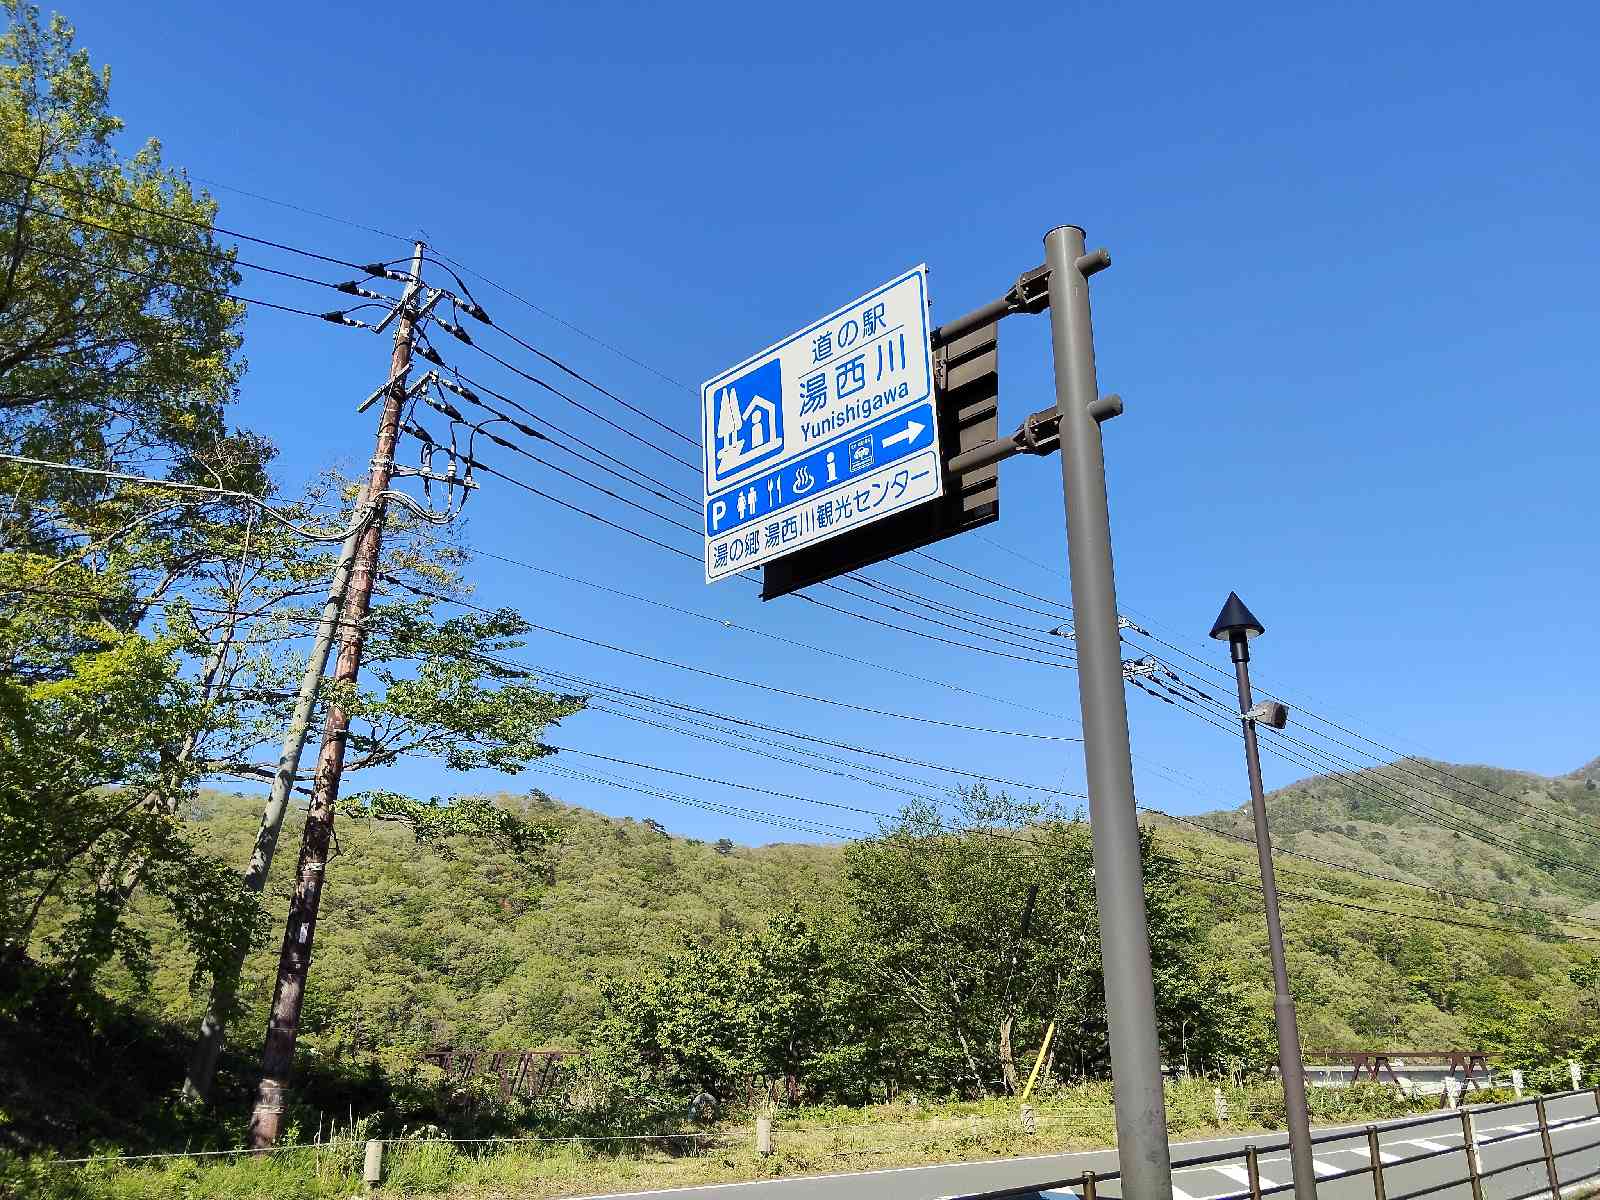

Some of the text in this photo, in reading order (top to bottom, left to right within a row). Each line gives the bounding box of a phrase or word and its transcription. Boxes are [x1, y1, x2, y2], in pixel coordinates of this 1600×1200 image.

[811, 302, 887, 364] 道の駅
[799, 334, 906, 417] 湯西川
[801, 382, 909, 442] Yunishigawa
[711, 502, 727, 530] P
[713, 470, 930, 568] 湯の郷 湯西川観光センター
